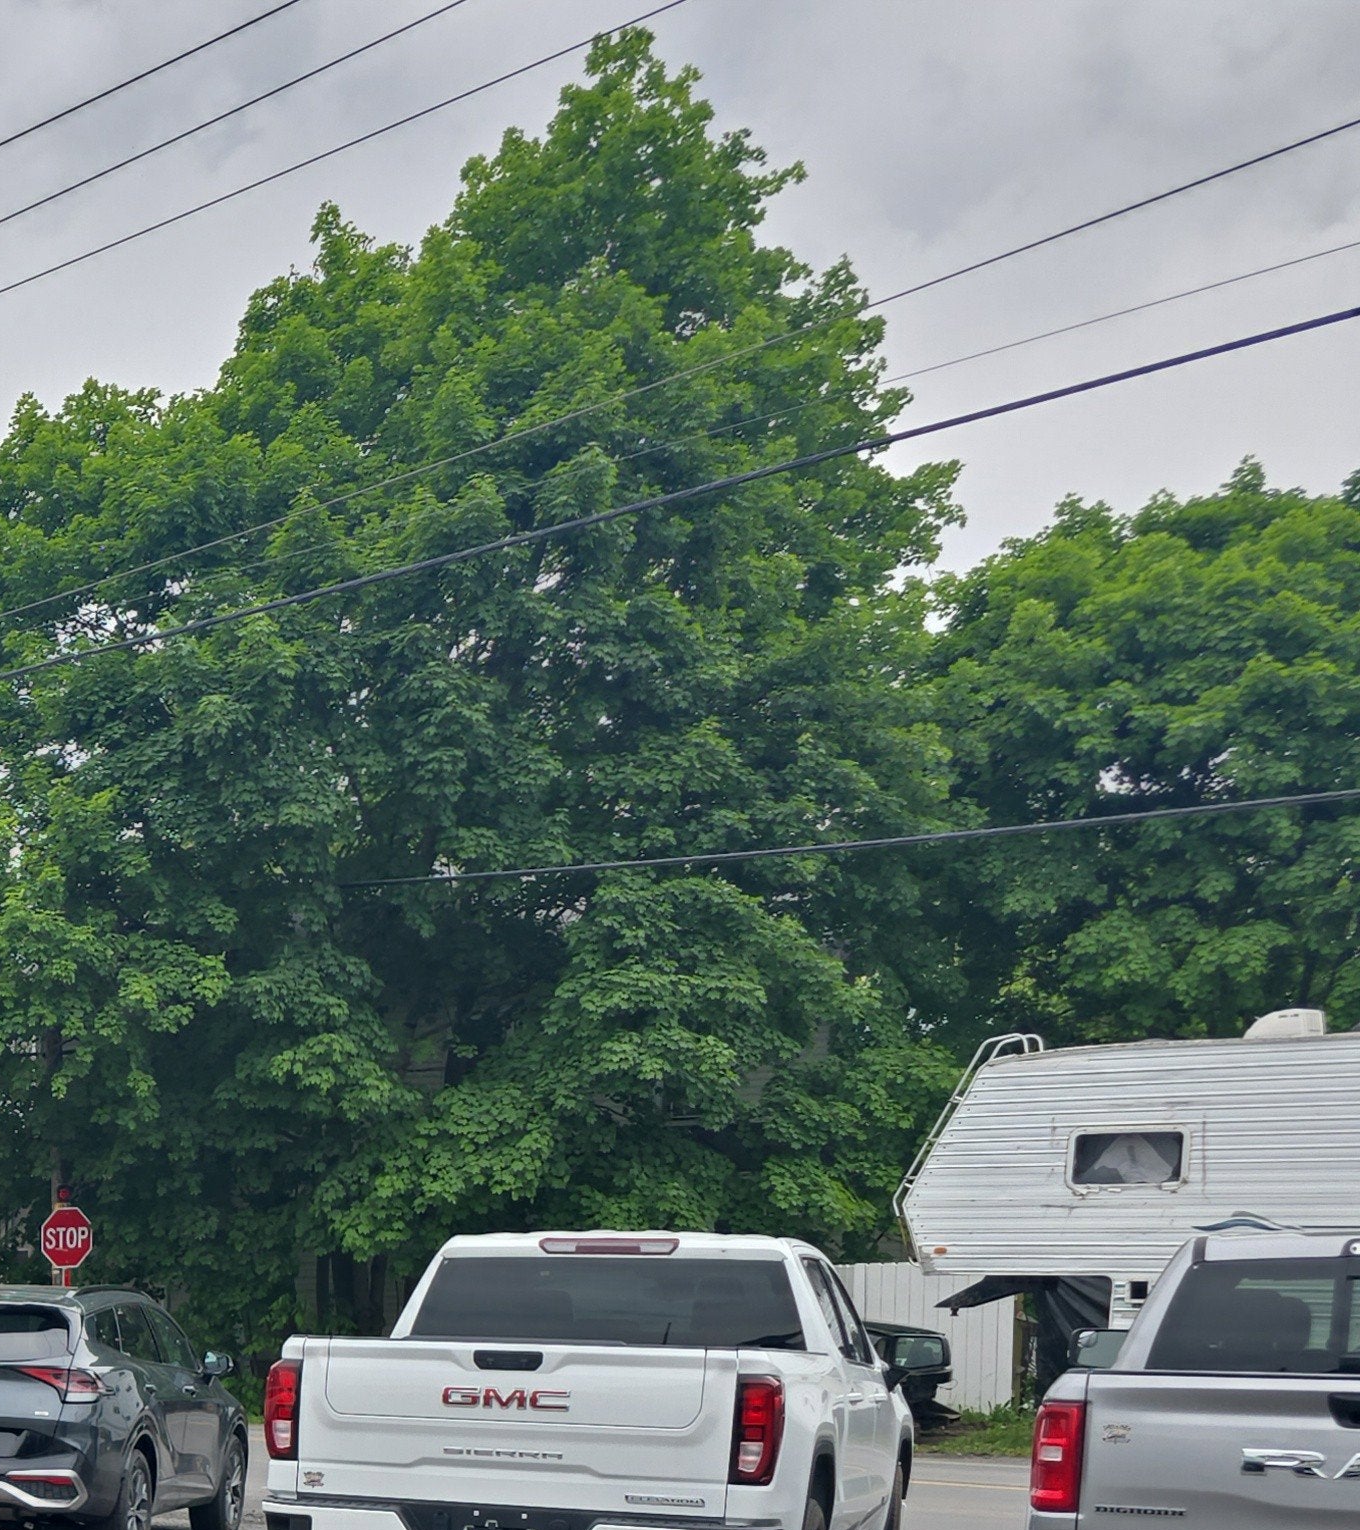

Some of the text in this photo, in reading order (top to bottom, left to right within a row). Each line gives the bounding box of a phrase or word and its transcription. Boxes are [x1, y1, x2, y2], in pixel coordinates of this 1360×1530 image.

[45, 1226, 89, 1250] STOP
[442, 1386, 571, 1412] GMC
[443, 1446, 564, 1460] SIERRA
